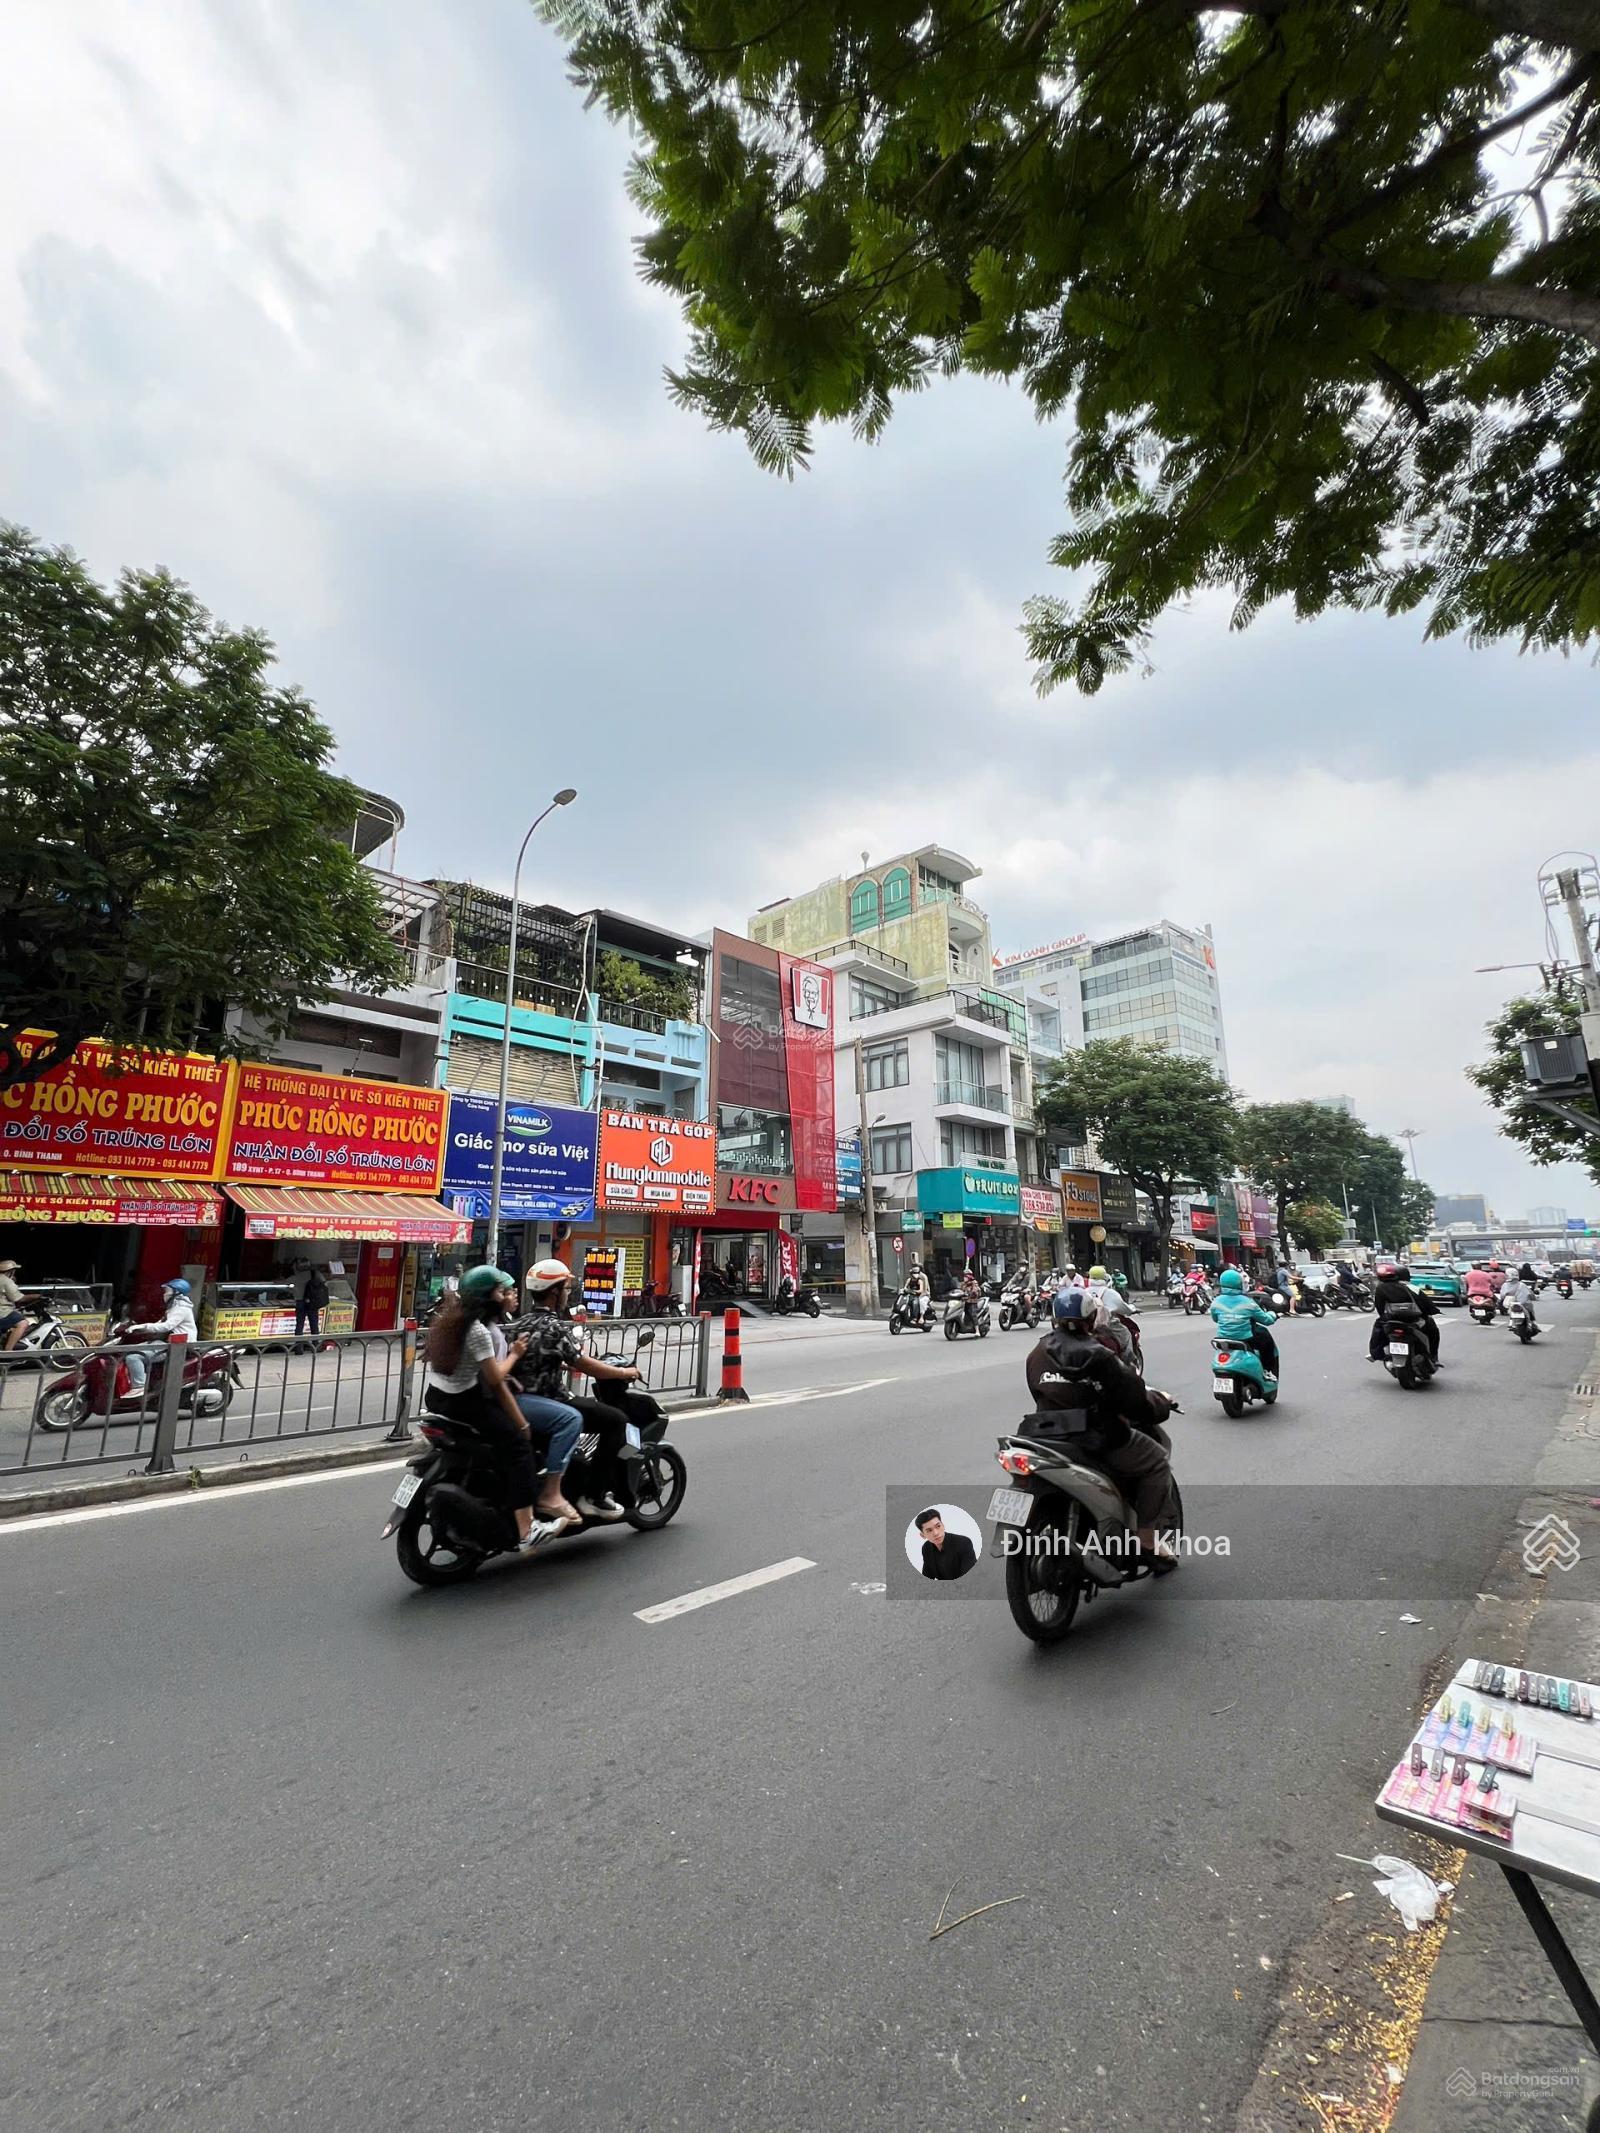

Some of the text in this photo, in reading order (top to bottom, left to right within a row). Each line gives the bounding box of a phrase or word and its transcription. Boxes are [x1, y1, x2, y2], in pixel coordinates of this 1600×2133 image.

[1005, 933, 1088, 964] KIM OANH GROUP
[144, 1057, 179, 1078] KIẾN
[184, 1062, 223, 1083] THIẾT
[30, 1070, 218, 1128] HỒNG PHƯỚC
[244, 1072, 442, 1114] HỆ THỐNG ĐẠI LÝ VÉ SỐ KIẾN THIẾT
[4, 1115, 213, 1154] ĐỔI SỐ TRÚNG LỚN
[239, 1098, 440, 1146] PHÚC HỒNG PHƯỚC
[507, 1114, 549, 1128] VINAMILK
[608, 1112, 714, 1139] BÁN TRẢ GÓP
[234, 1140, 436, 1174] NHẬN ĐỔI SỐ TRÚNG LỚN
[454, 1132, 494, 1151] Giấc
[528, 1141, 558, 1157] sữa
[561, 1144, 590, 1163] Việt
[606, 1162, 712, 1187] Hunglammobile
[975, 1178, 1019, 1196] FRUIT BOX
[728, 1177, 782, 1205] KFC
[1065, 1182, 1078, 1201] F5
[55, 1208, 117, 1223] PHƯỚC
[275, 1225, 314, 1239] PHÚC
[355, 1228, 397, 1241] PHƯỚC
